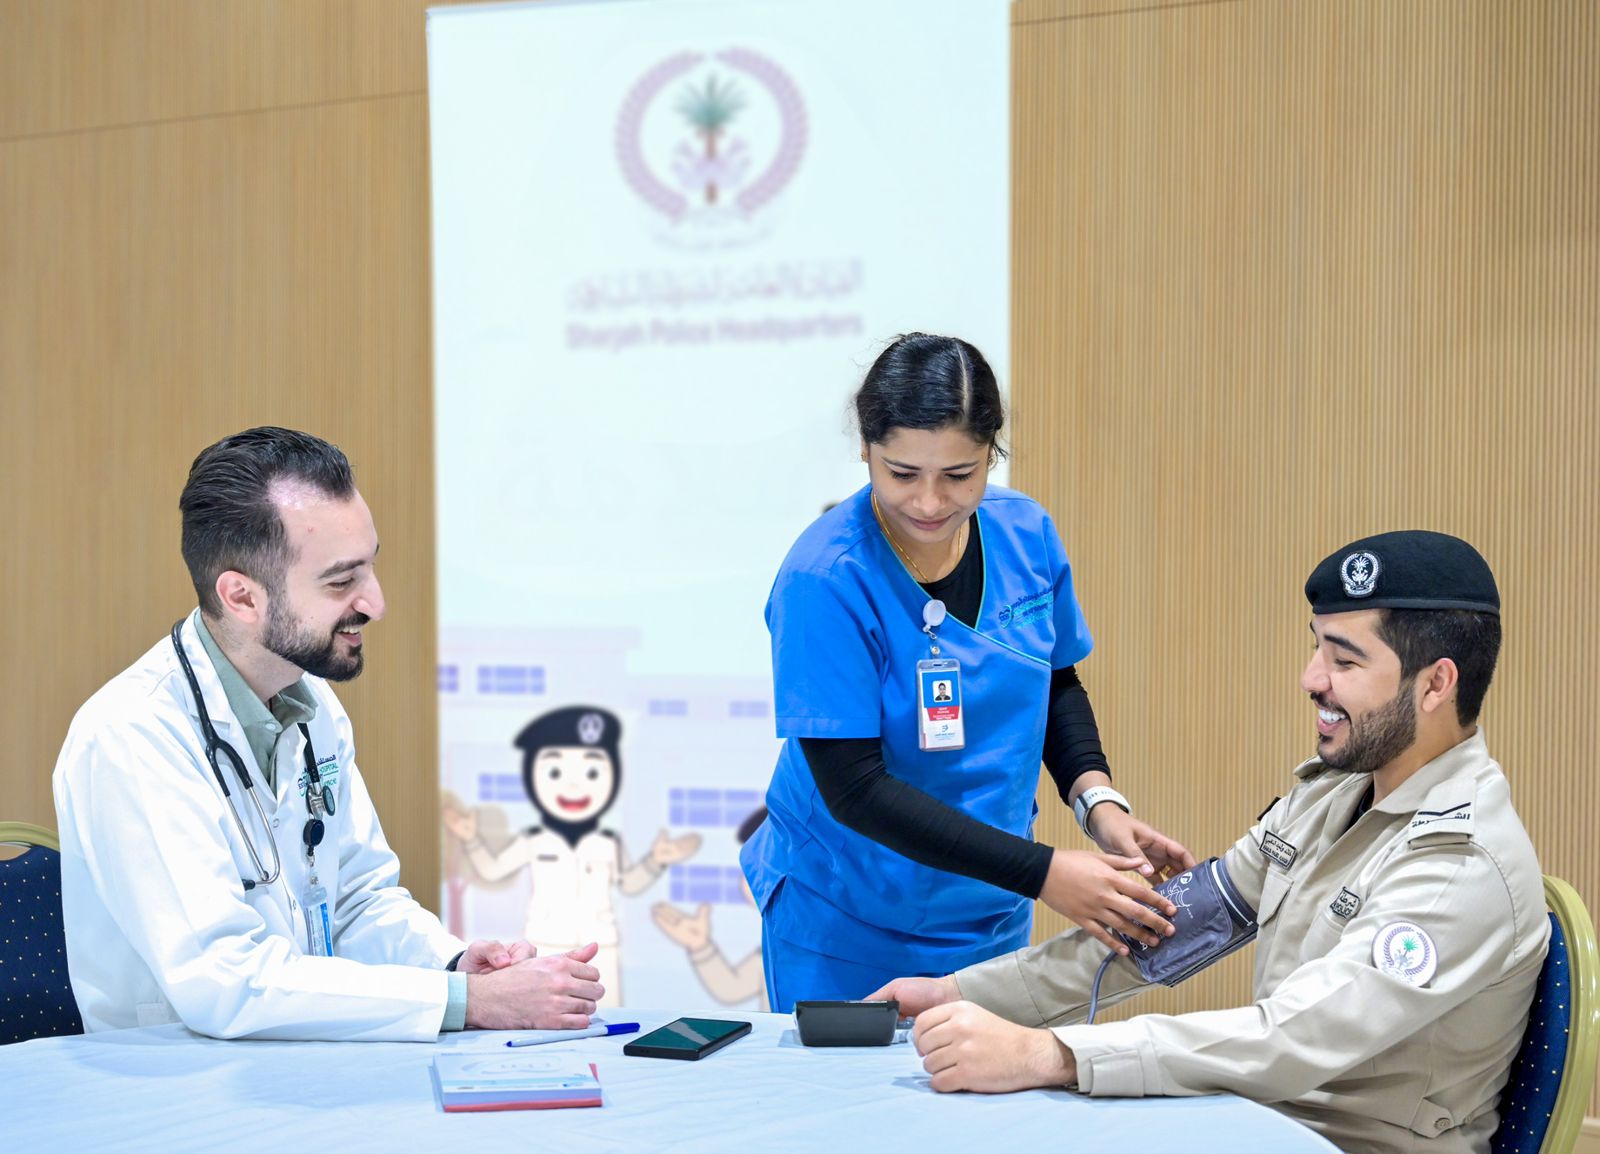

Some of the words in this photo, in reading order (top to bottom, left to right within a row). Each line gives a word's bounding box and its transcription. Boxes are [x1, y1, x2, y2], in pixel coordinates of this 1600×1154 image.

[567, 321, 645, 352] Sharjah
[650, 317, 711, 346] Police
[717, 311, 863, 345] Headquarters
[1340, 892, 1357, 907] شرطة
